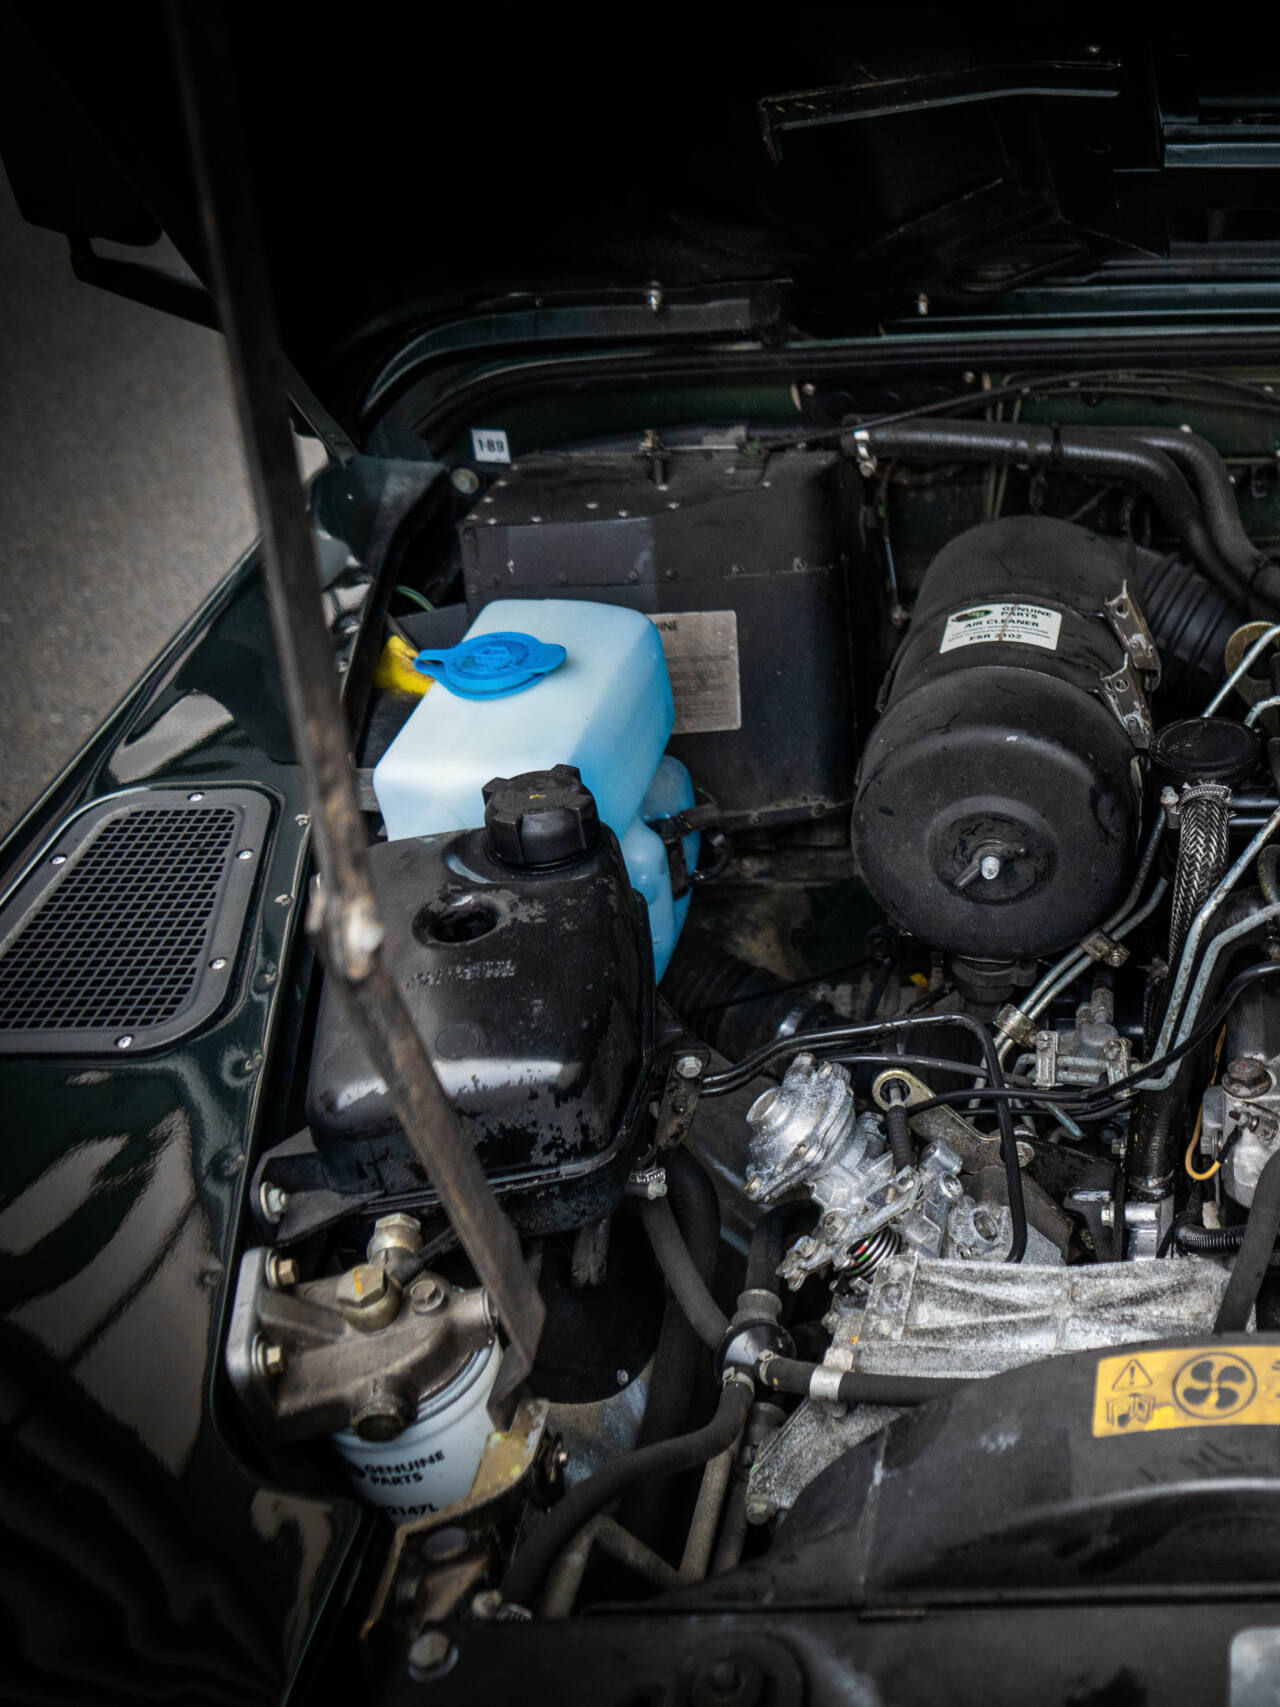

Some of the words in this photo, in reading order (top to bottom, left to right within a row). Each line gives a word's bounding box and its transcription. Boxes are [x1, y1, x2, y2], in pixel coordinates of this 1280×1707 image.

[1001, 611, 1038, 620] PARTS
[1002, 606, 1052, 617] GENUINE
[965, 620, 982, 628] AIR
[986, 619, 1039, 627] CLEANER
[364, 1449, 445, 1474] GENUINE
[370, 1472, 424, 1485] PARTS
